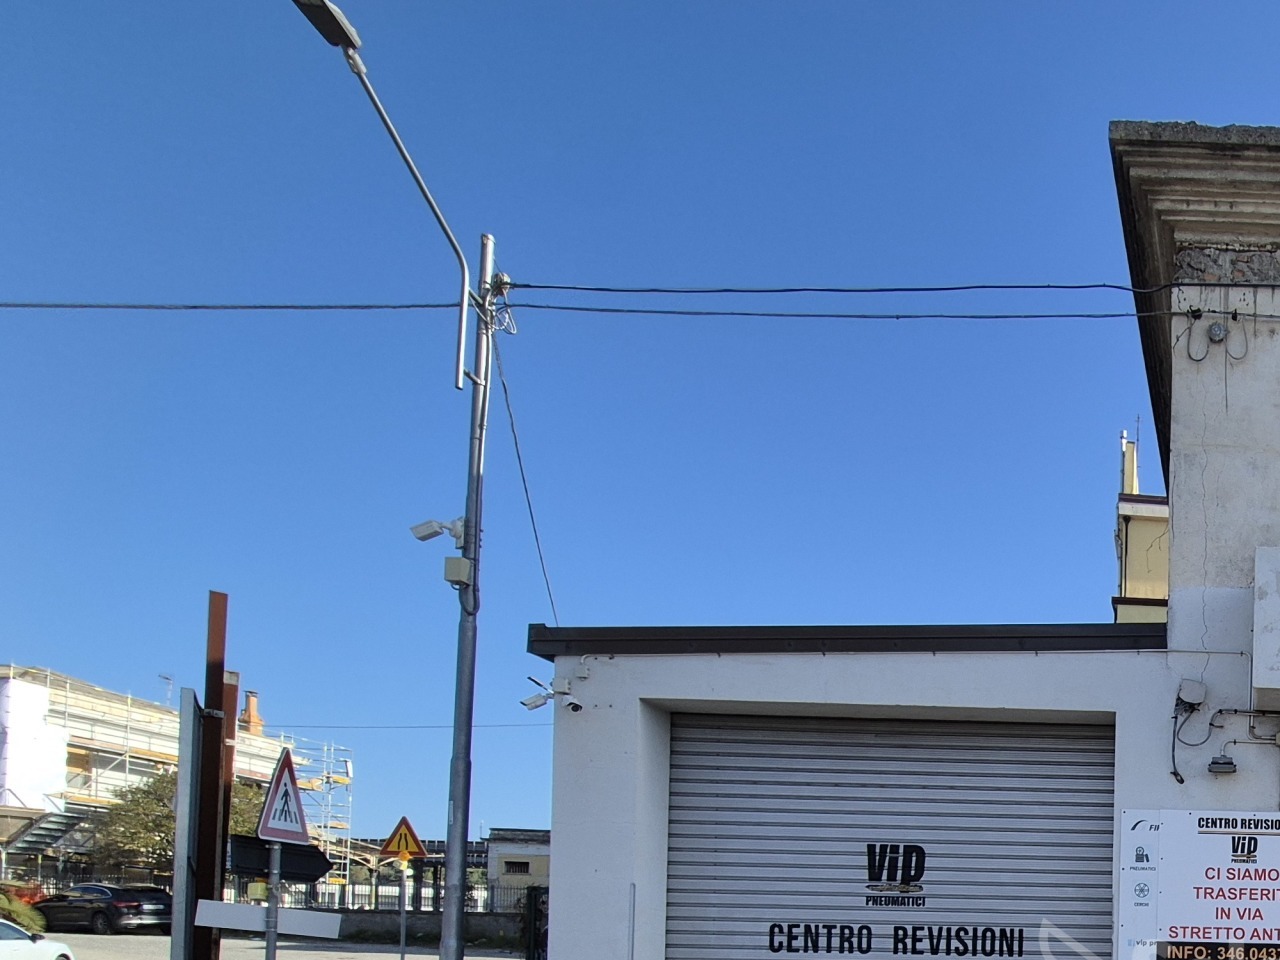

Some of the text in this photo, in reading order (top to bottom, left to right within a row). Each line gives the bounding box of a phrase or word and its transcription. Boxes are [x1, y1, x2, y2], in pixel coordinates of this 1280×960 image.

[1197, 817, 1238, 829] CENTRO
[1204, 867, 1280, 881] CI SIAMO
[865, 896, 927, 907] PNEUMATICI
[1215, 907, 1264, 921] IN VIA
[1168, 926, 1246, 940] STRETTO
[768, 923, 1025, 958] CENTRO REVISIONI
[1167, 945, 1212, 960] INFO:
